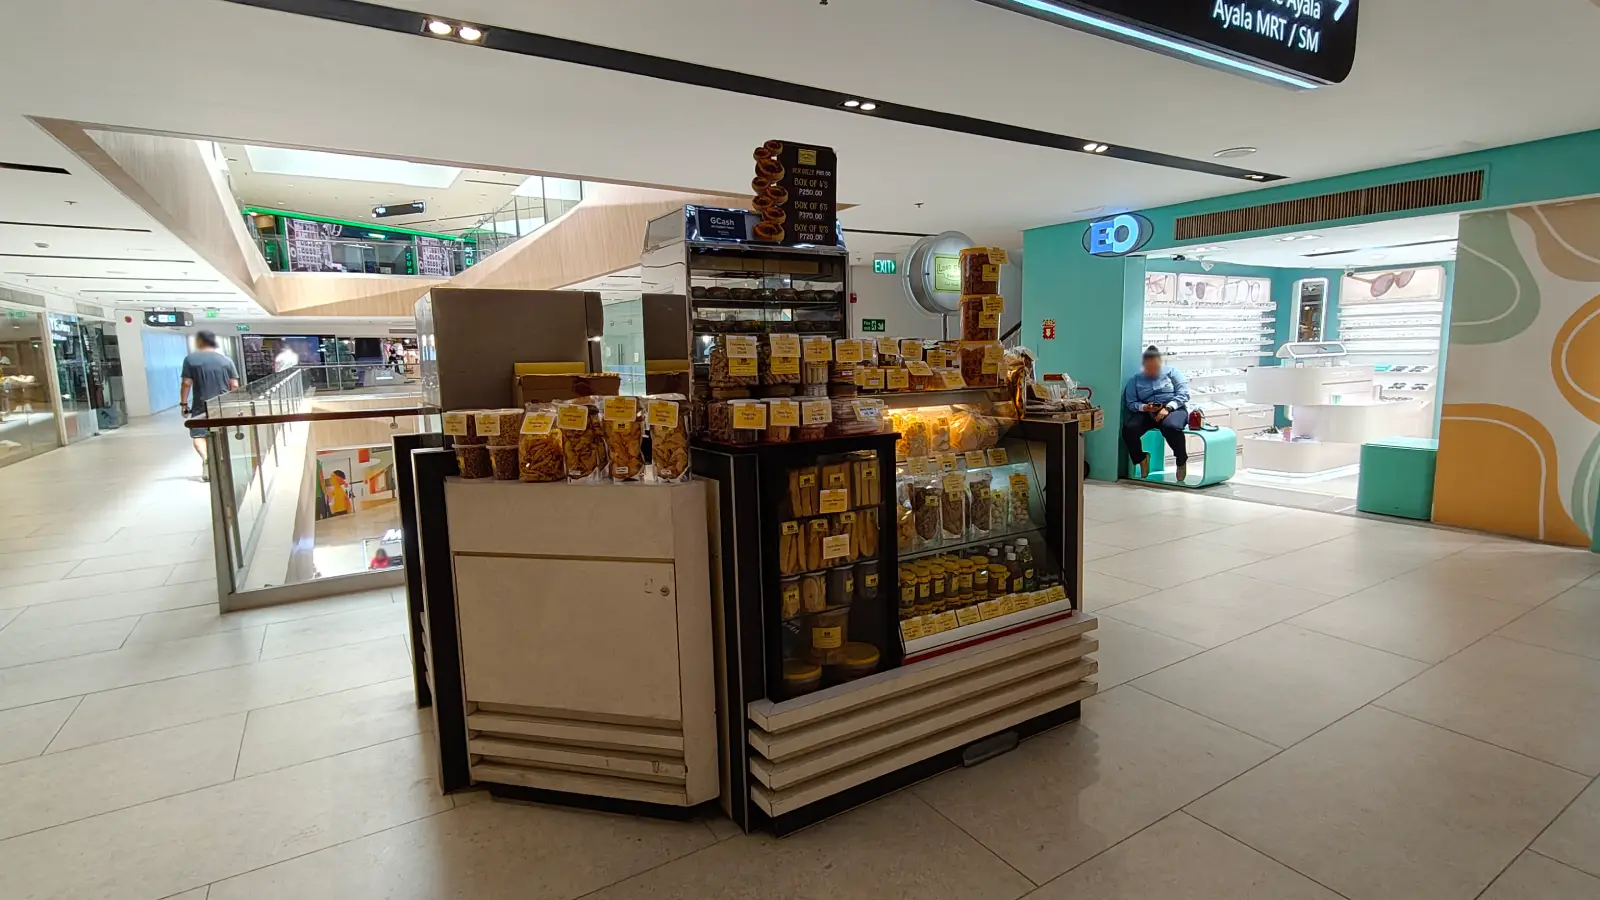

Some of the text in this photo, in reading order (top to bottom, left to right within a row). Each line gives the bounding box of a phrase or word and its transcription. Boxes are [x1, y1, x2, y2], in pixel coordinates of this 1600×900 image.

[1287, 0, 1321, 20] Ayala
[1212, 0, 1320, 54] Ayala MRT / SM
[794, 177, 808, 187] BOX
[809, 179, 818, 188] OF
[794, 200, 808, 209] BOX
[809, 202, 818, 210] OF
[710, 216, 735, 226] GCash
[798, 211, 823, 221] P370.00
[794, 223, 808, 232] BOX
[808, 224, 818, 233] OF
[799, 232, 823, 241] P720.00
[1090, 214, 1140, 255] EO
[874, 259, 893, 273] EXIT
